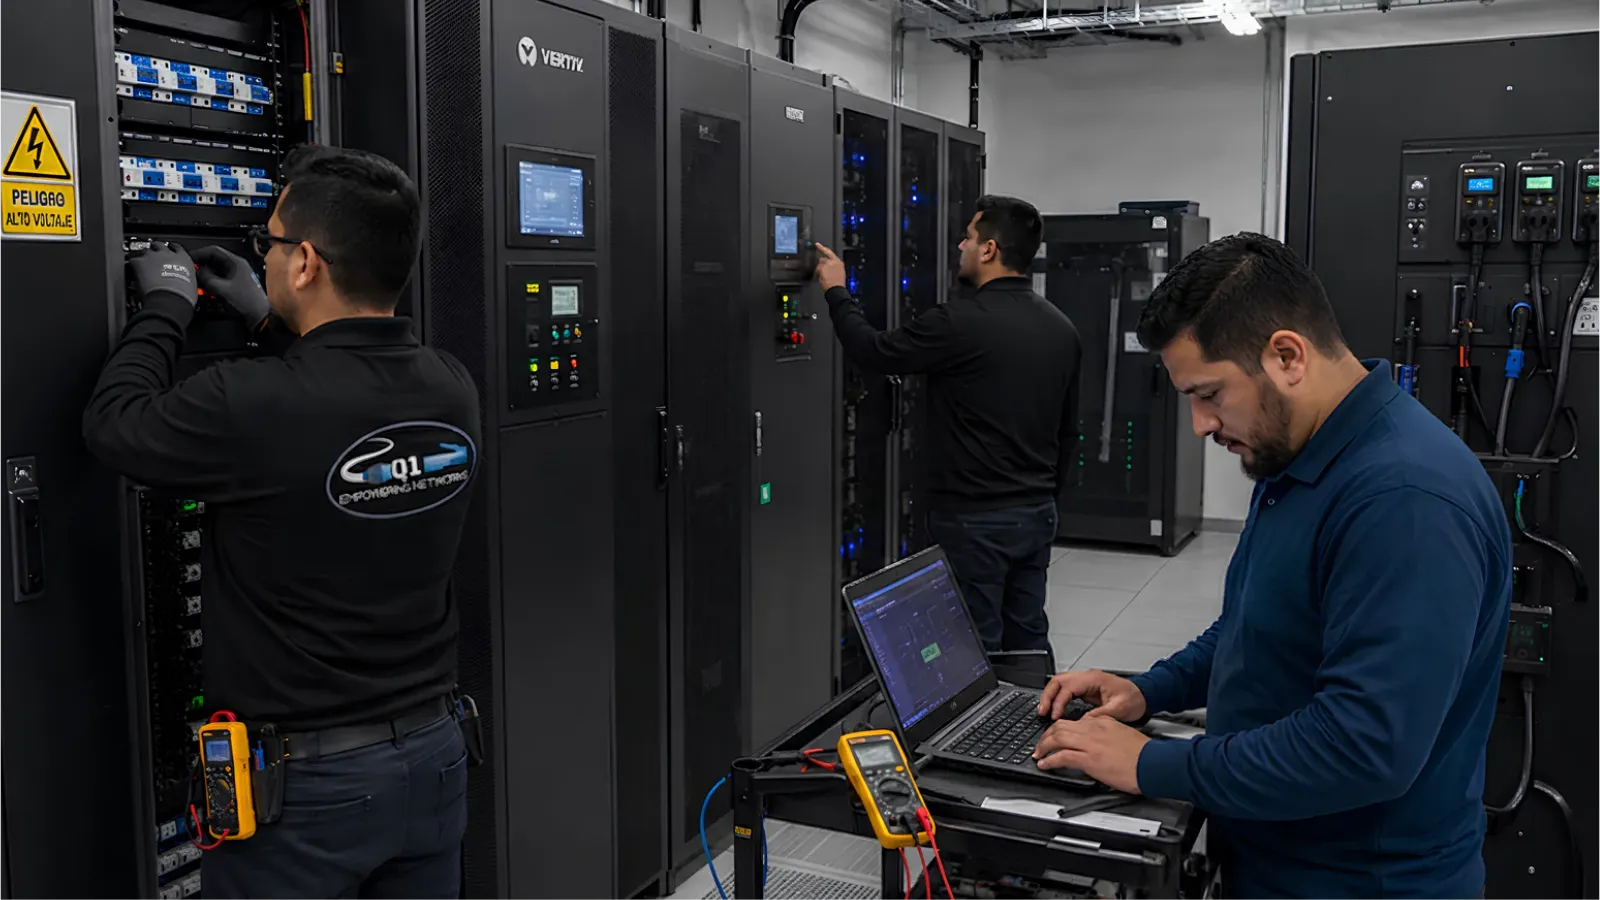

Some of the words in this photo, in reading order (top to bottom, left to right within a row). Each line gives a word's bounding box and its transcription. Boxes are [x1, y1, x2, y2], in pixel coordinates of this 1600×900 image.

[12, 188, 65, 207] PELIGRO
[6, 211, 30, 226] ALTO
[391, 455, 422, 482] Q1
